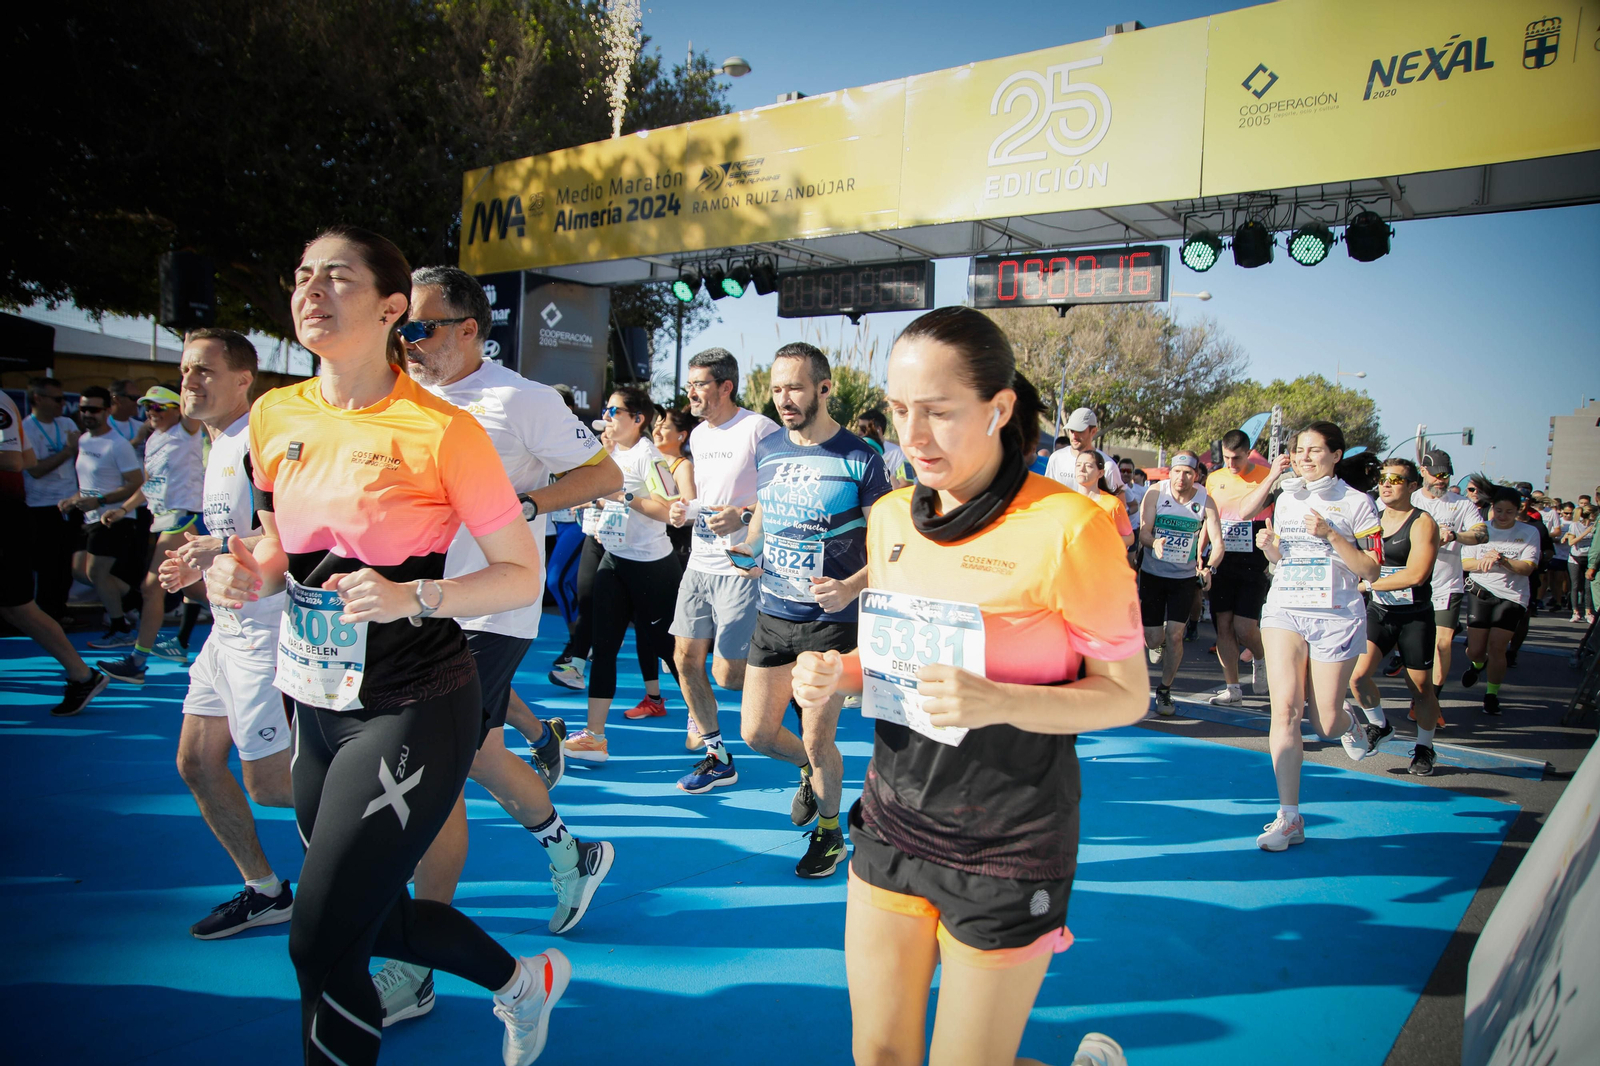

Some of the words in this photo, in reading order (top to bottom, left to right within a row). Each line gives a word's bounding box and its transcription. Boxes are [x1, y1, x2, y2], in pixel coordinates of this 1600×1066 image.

[1372, 88, 1397, 100] 2020
[987, 55, 1112, 167] 25
[1239, 91, 1338, 117] COOPERACIÓN
[1238, 114, 1271, 129] 2005
[728, 168, 760, 179] SERIES
[984, 159, 1109, 200] EDICIÓN
[556, 182, 603, 205] Medio
[609, 168, 683, 197] Maratón
[692, 193, 740, 214] RAMÓN
[746, 190, 779, 206] RUIZ
[784, 177, 855, 201] ANDÚJAR
[554, 201, 622, 233] Almería
[626, 193, 681, 222] 2024
[539, 328, 593, 344] COOPERACIÓN
[539, 337, 558, 347] 2005
[352, 450, 401, 466] COSENTINO
[774, 489, 826, 512] MEDIA
[792, 520, 829, 533] Roquetas
[1159, 535, 1189, 548] 246
[768, 546, 816, 571] 5824
[962, 554, 1018, 570] COSENTINO
[1282, 566, 1327, 582] 5229
[304, 596, 324, 606] 2024
[869, 615, 966, 669] 5331
[305, 644, 339, 657] BELEN
[395, 744, 410, 779] 2XU
